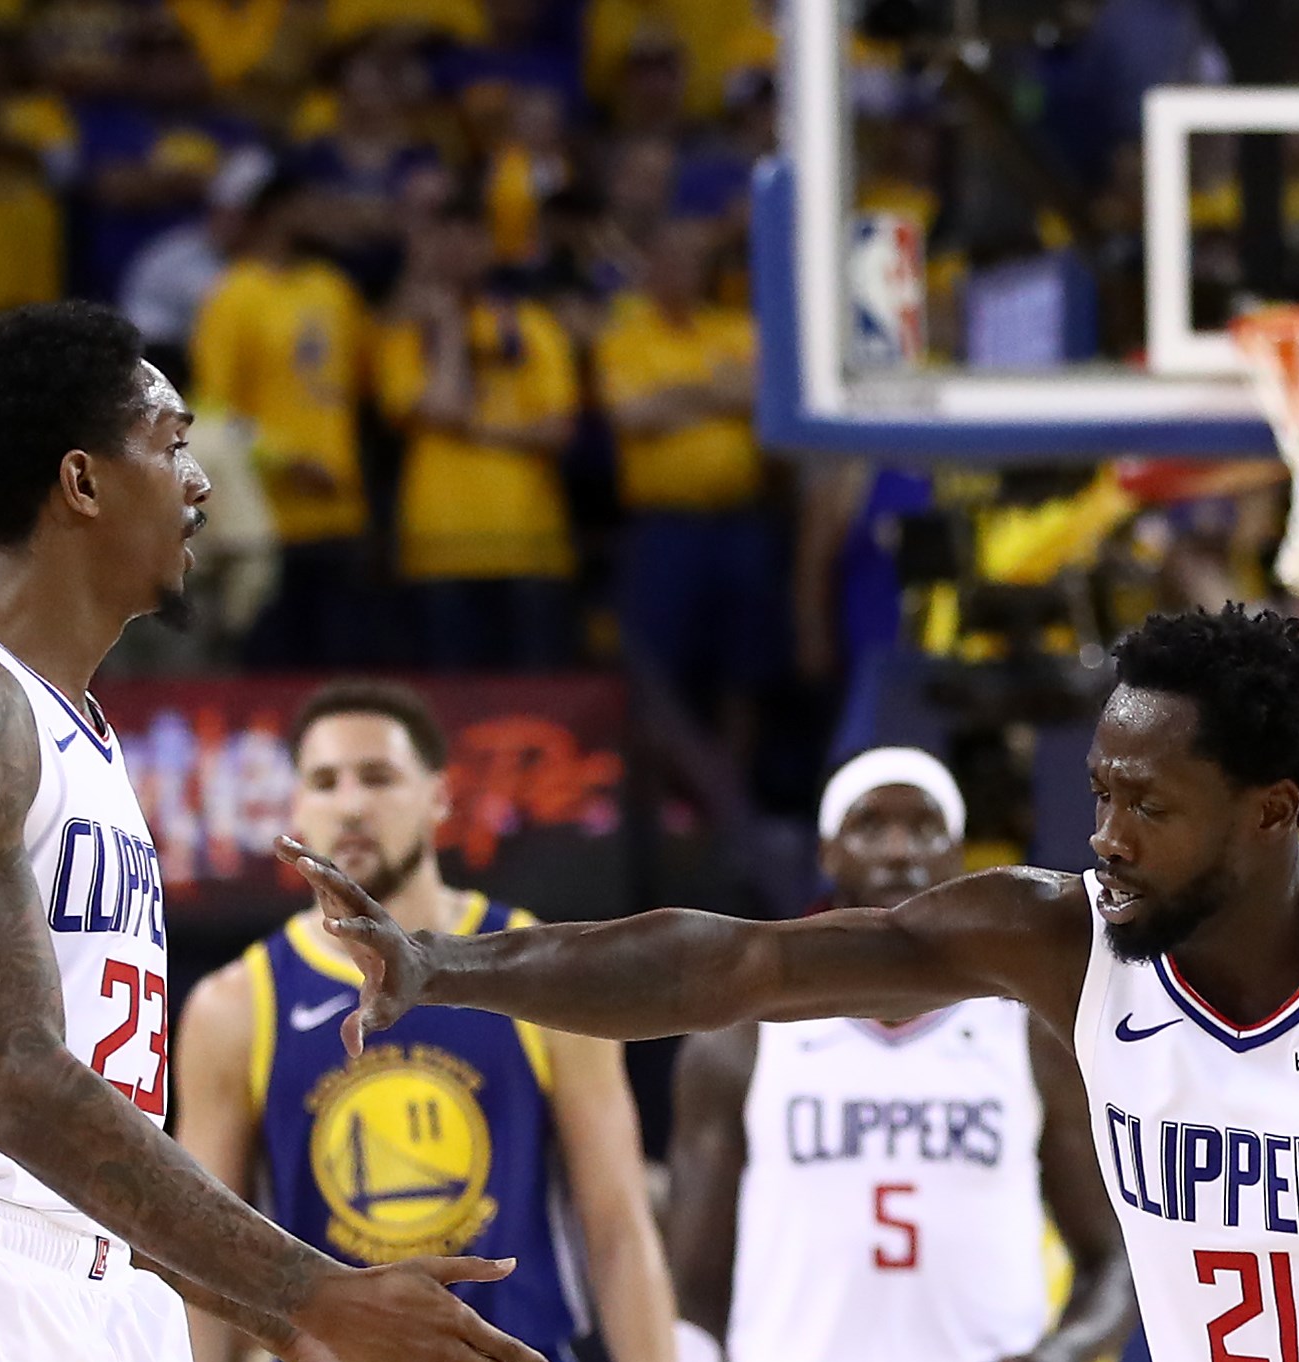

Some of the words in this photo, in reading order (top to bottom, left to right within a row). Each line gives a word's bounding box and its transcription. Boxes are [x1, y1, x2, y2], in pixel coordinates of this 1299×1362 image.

[90, 957, 168, 1117] 23
[406, 1097, 442, 1143] 11
[786, 1096, 1003, 1167] CLIPPERS
[872, 1182, 919, 1269] 5
